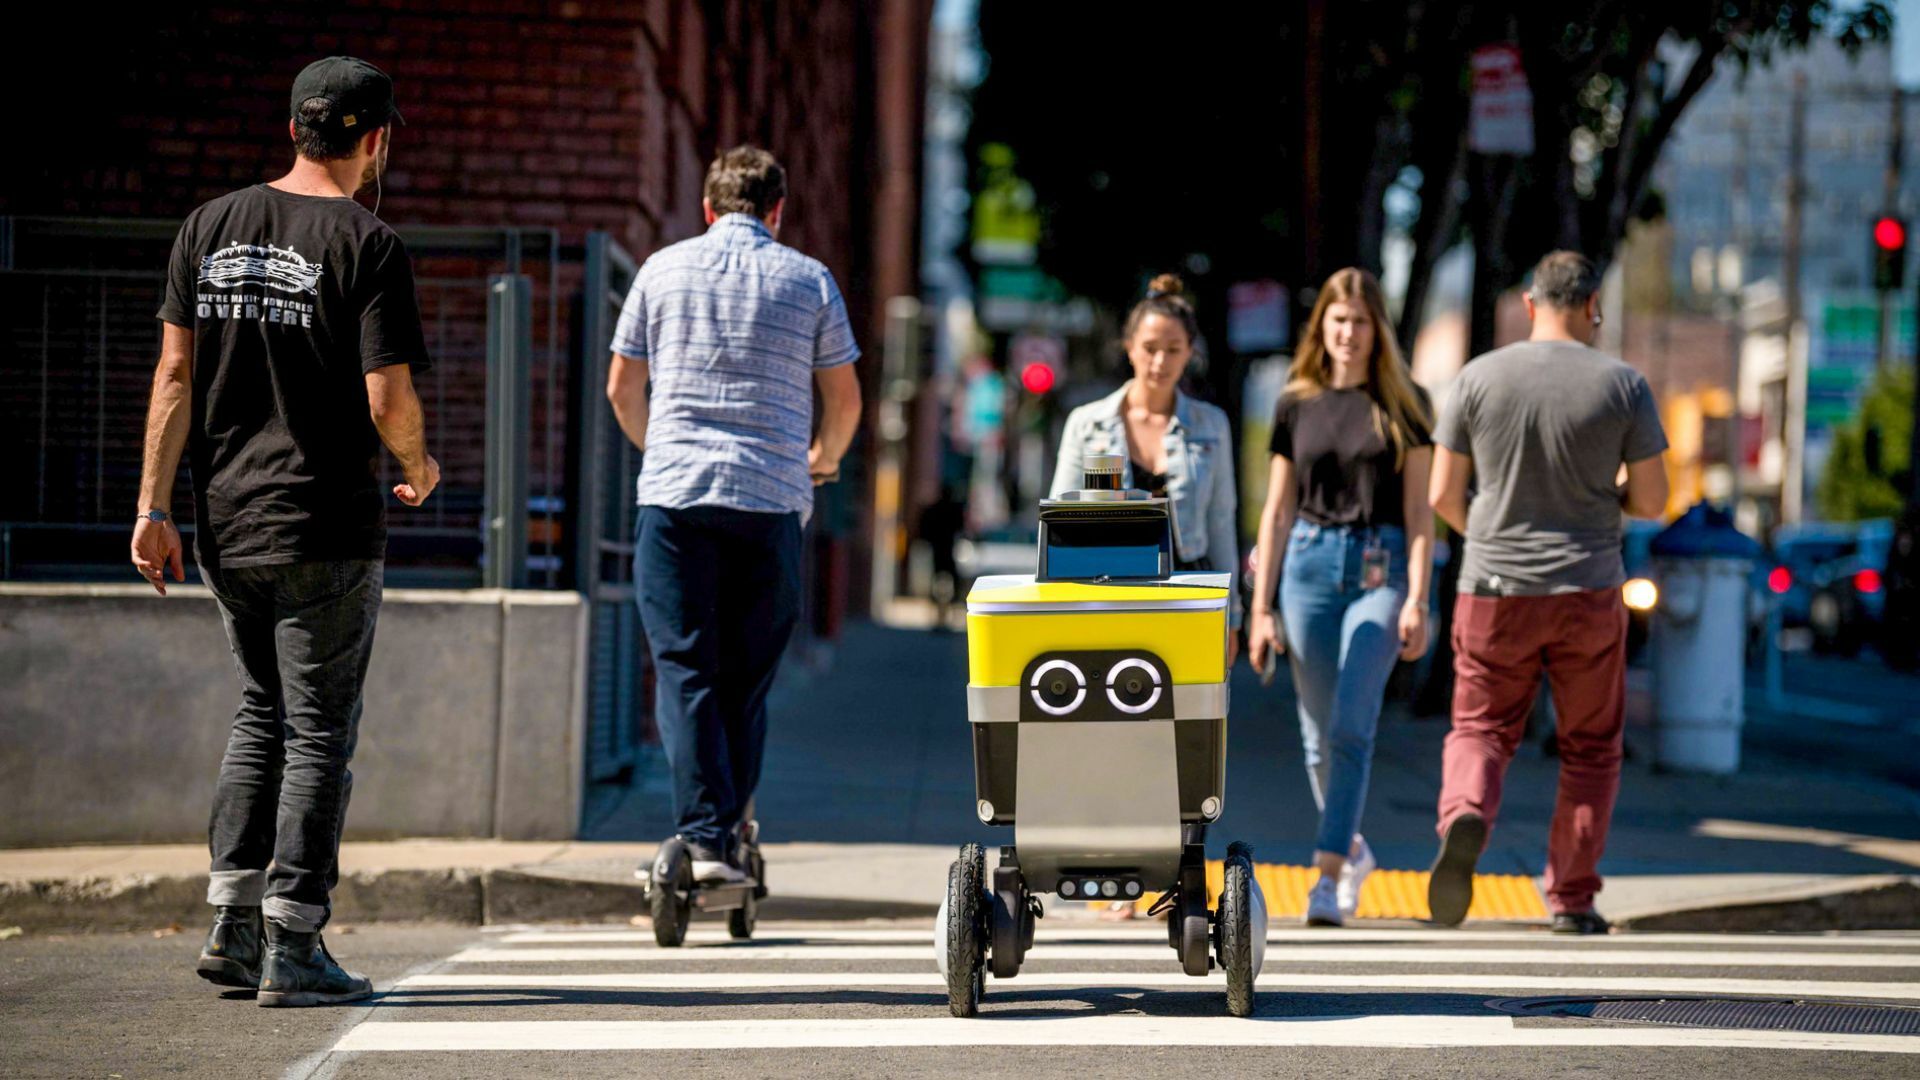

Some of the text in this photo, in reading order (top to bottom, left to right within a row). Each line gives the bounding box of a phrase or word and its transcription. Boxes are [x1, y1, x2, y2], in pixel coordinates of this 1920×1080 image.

[197, 293, 228, 303] WE'RE
[197, 303, 312, 328] OVER ERE
